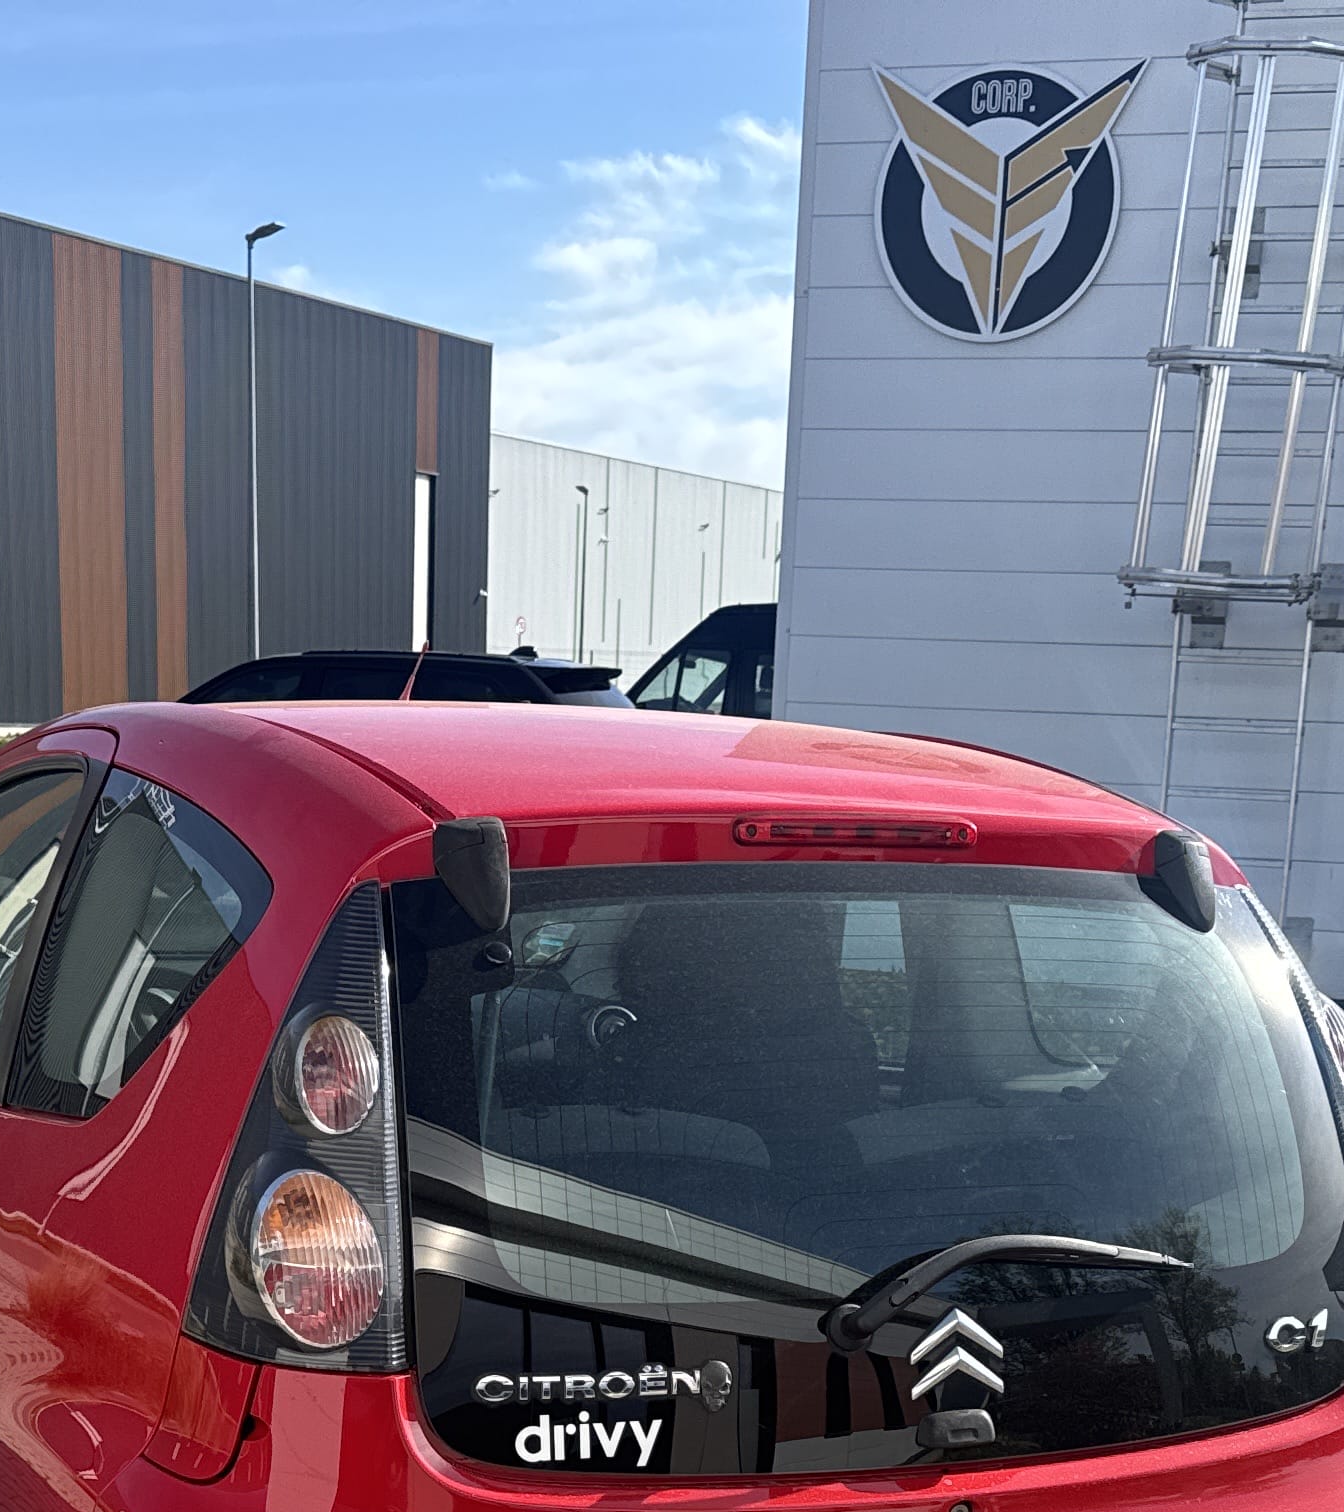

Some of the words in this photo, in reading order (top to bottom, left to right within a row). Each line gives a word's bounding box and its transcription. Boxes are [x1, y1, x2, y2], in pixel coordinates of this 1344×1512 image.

[971, 78, 1036, 115] CORP.
[1265, 1308, 1329, 1353] C1
[476, 1363, 701, 1402] CITROËN
[515, 1410, 662, 1467] drivy
